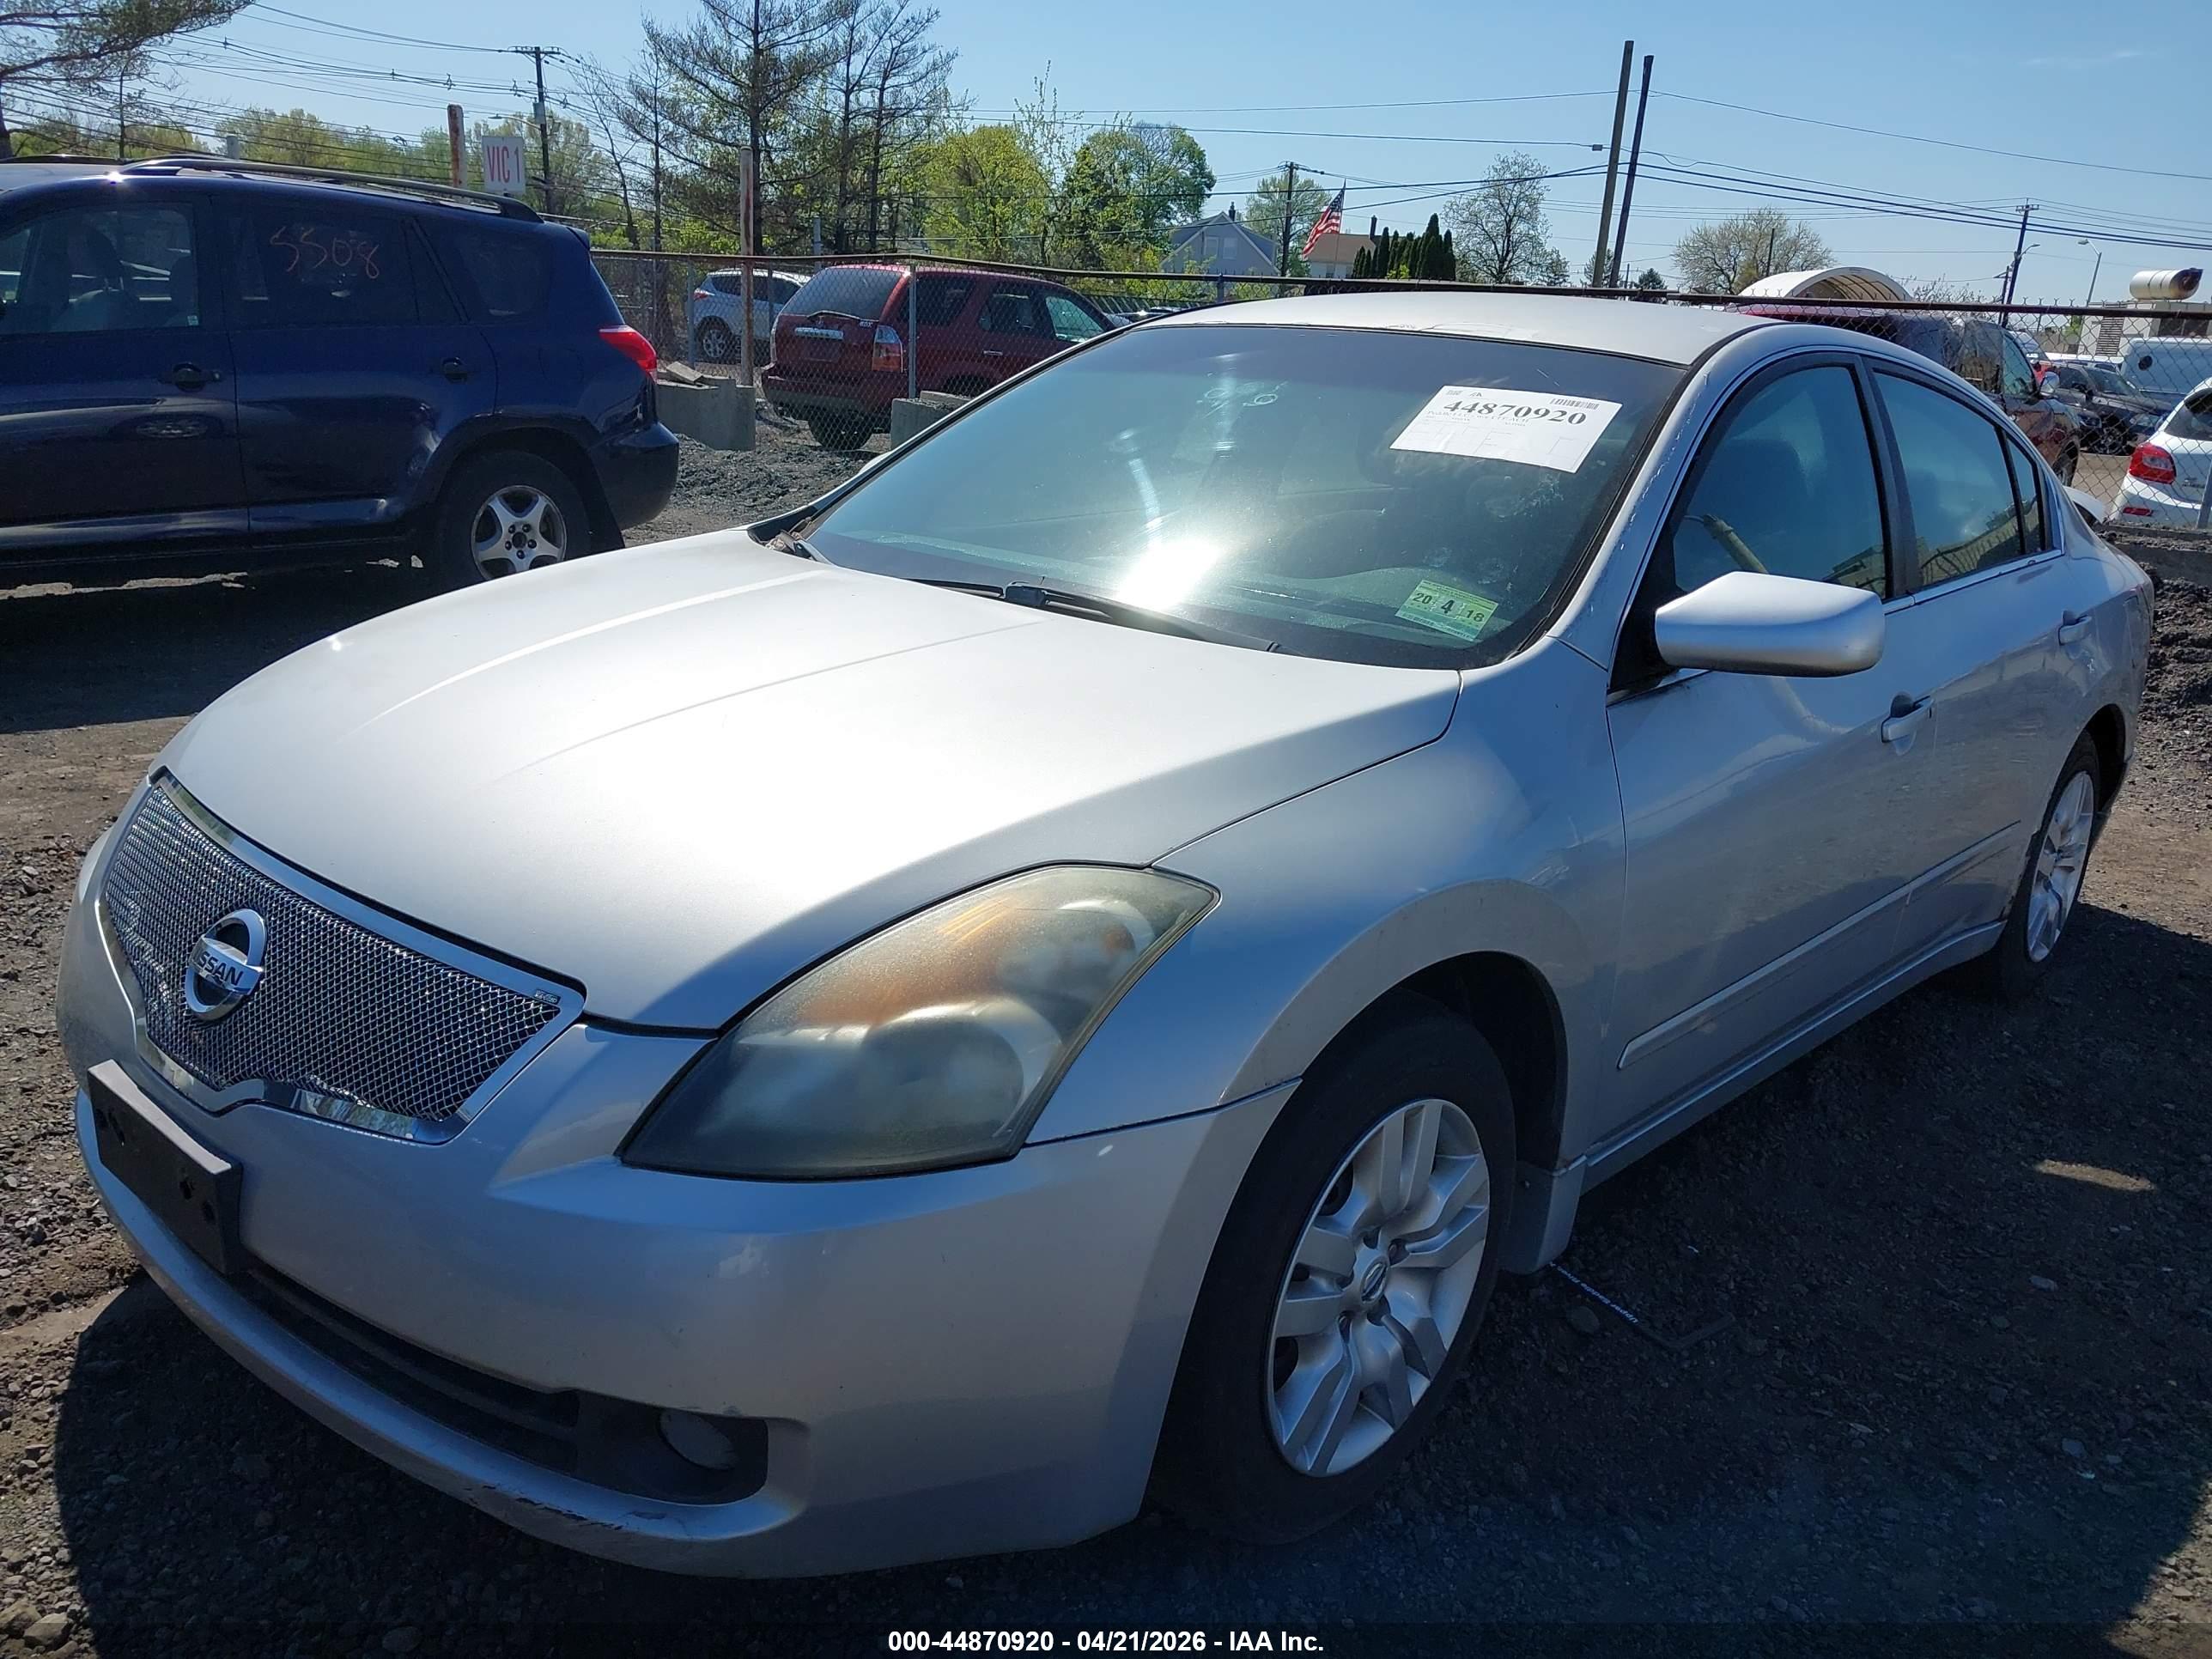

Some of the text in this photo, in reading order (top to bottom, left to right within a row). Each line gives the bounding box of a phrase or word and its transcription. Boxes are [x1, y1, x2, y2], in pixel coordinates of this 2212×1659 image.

[486, 144, 520, 184] VIC 1
[1443, 399, 1587, 425] 44870920
[1413, 592, 1433, 605] 20
[1441, 599, 1455, 614] 4
[1467, 610, 1485, 623] 18
[191, 950, 245, 986] SSAN
